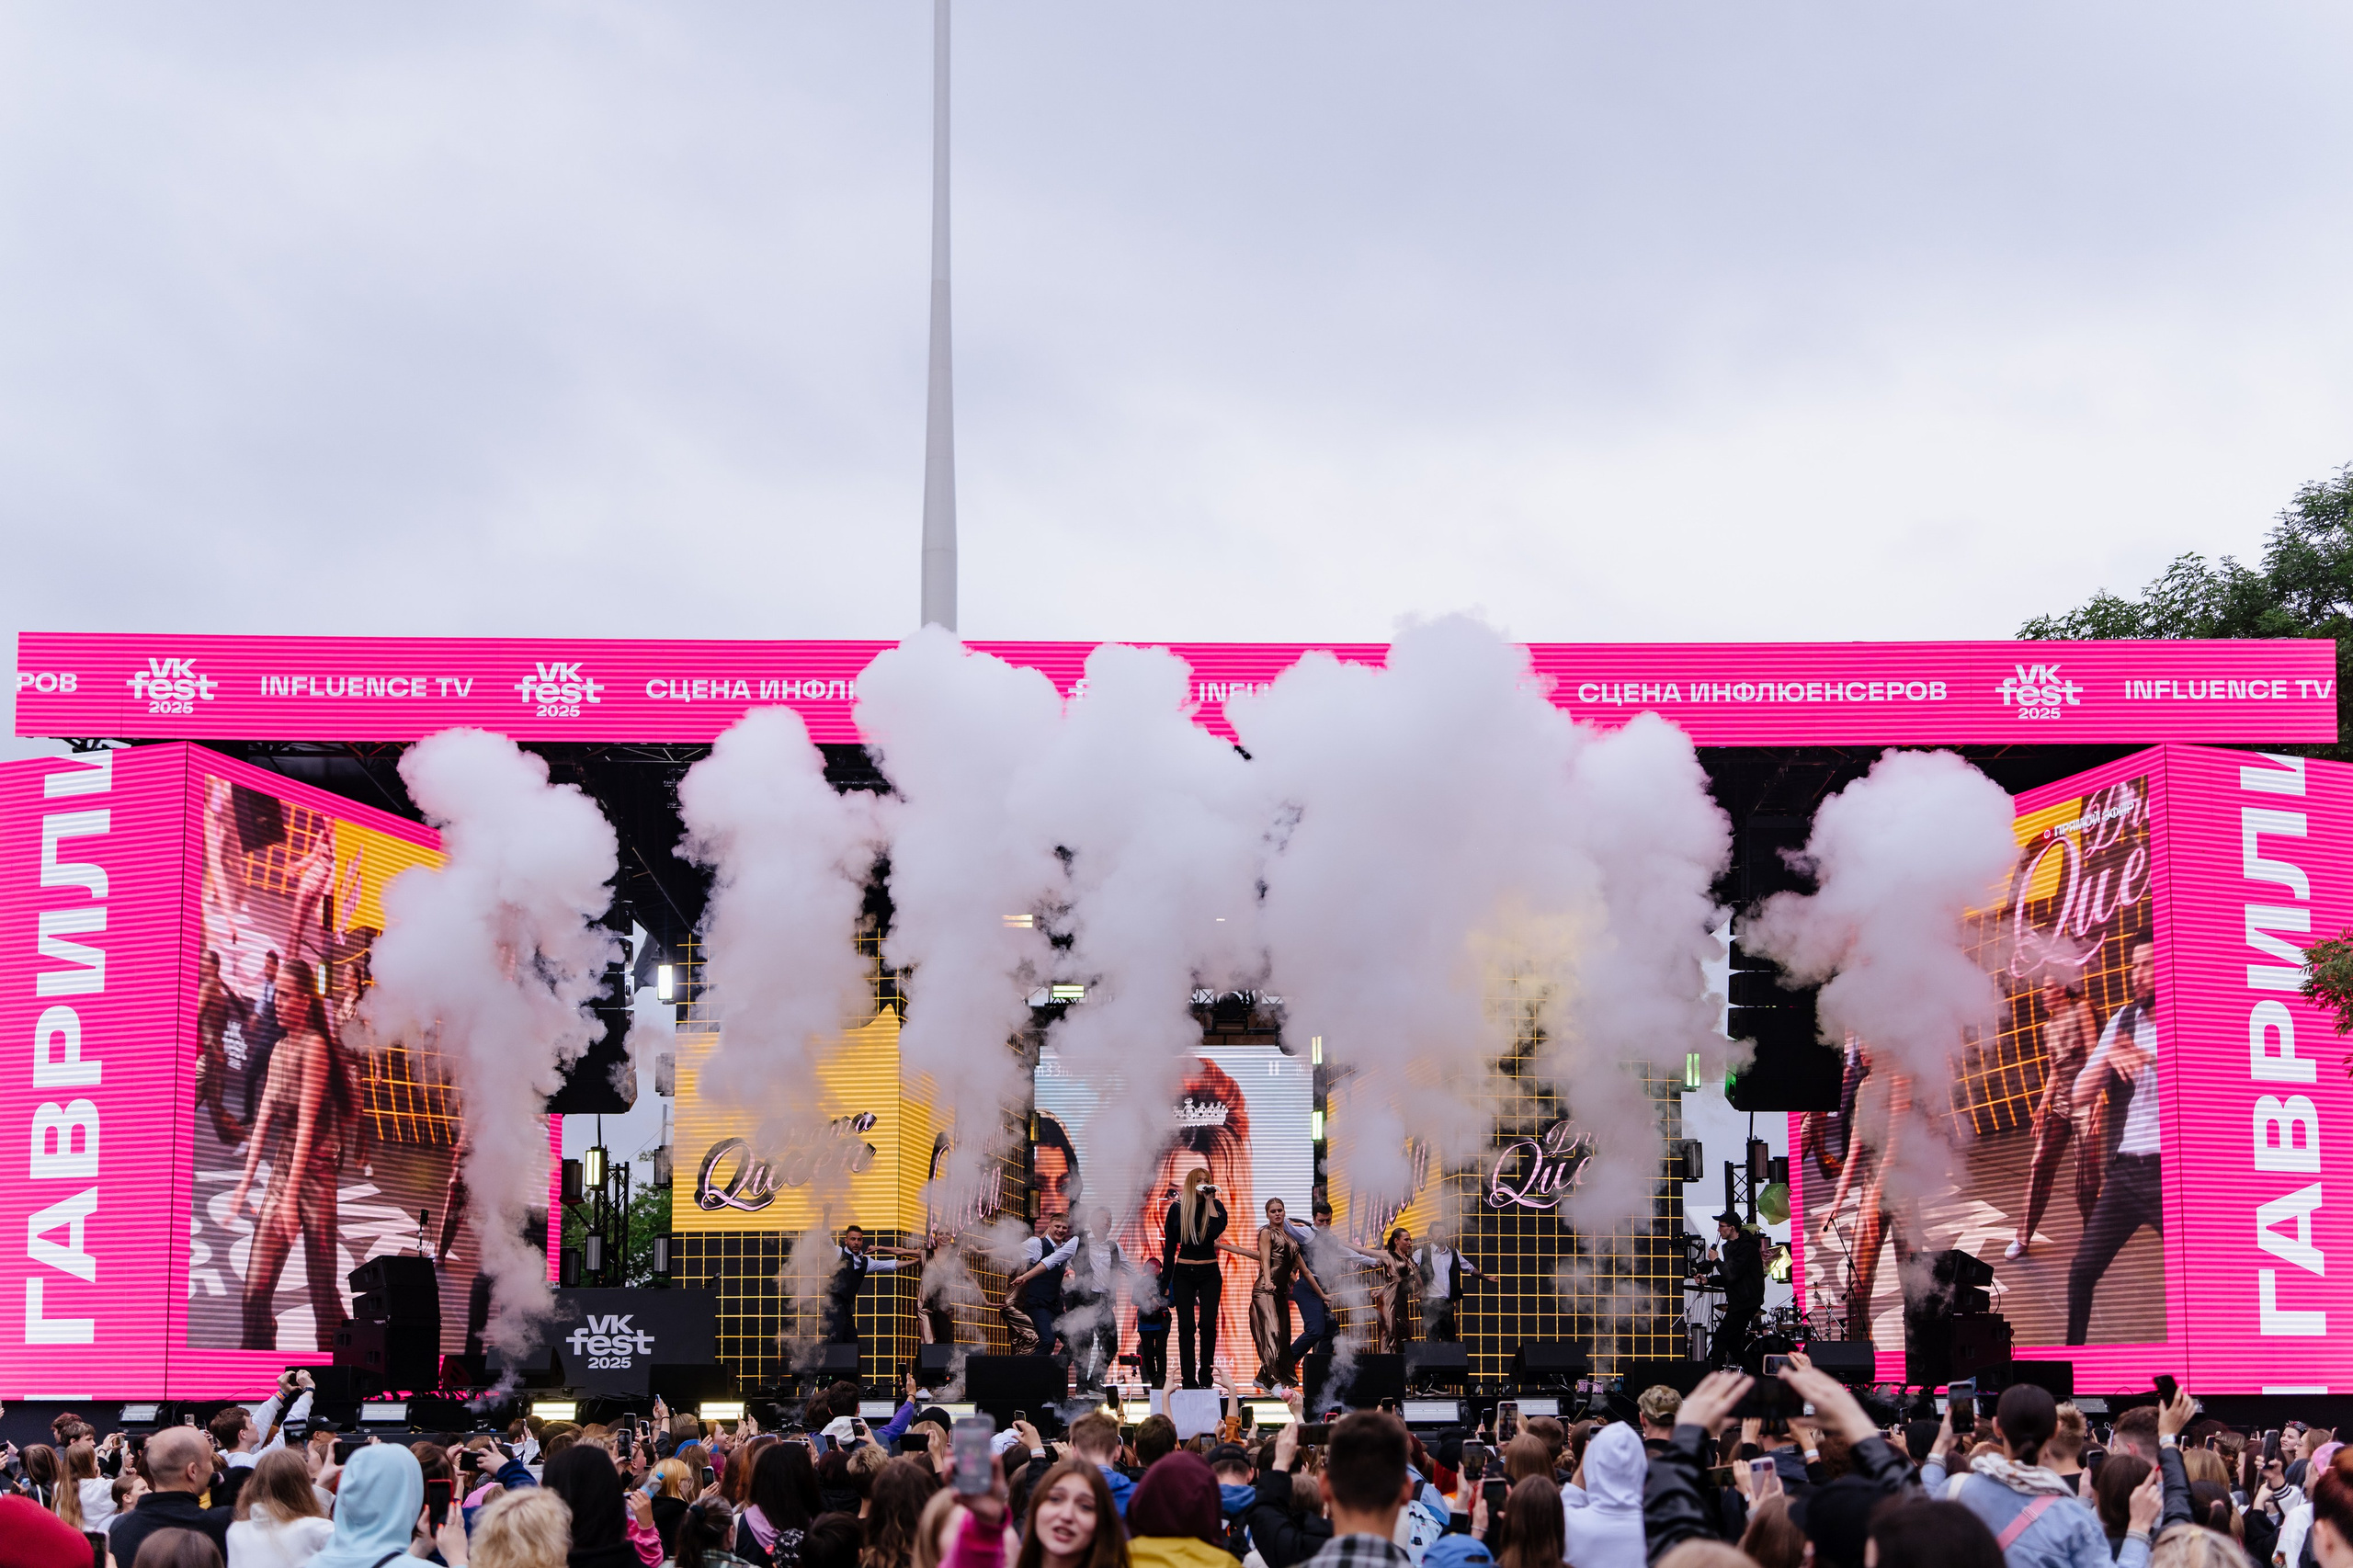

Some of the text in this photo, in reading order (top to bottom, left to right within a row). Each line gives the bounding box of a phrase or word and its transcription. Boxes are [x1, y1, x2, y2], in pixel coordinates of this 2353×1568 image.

[148, 657, 197, 678] VK
[535, 662, 584, 682] VK
[2015, 665, 2063, 685] VK
[126, 671, 218, 700] fest
[261, 676, 473, 697] INFLUENCE TV
[514, 675, 605, 704] fest
[645, 679, 752, 702] СЦЕНА
[1577, 681, 1948, 706] СЦЕНА ИНФЛЮЕНСЕРОВ
[1995, 677, 2084, 706] fest
[2125, 679, 2333, 699] INFLUENCE TV
[148, 701, 194, 714] 2025
[536, 704, 581, 717] 2025
[2018, 707, 2061, 720] 2025
[2053, 801, 2135, 836] ПРЯМОЙ ЭФИР
[696, 1138, 878, 1211] Queen
[1488, 1140, 1596, 1209] Que
[587, 1314, 634, 1335] VK
[566, 1327, 654, 1356] fest
[587, 1357, 632, 1369] 2025
[1214, 1356, 1235, 1369] 014
